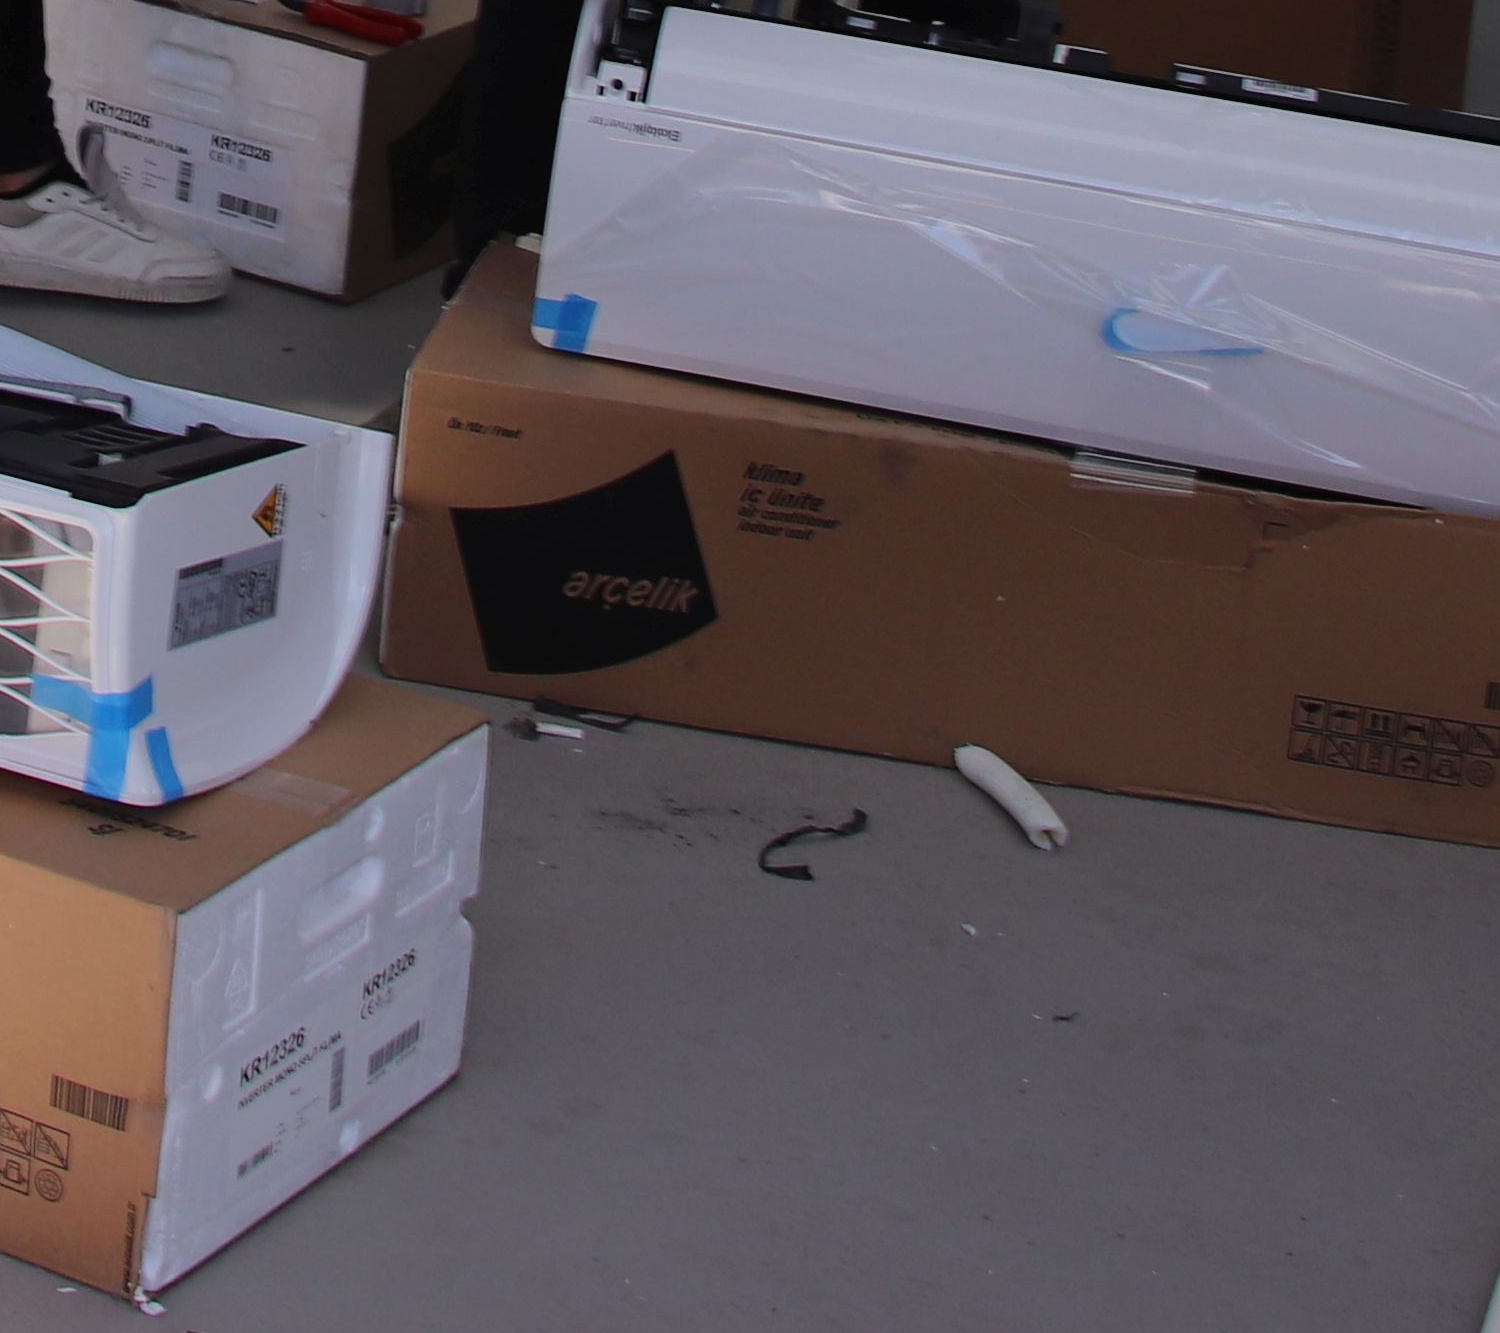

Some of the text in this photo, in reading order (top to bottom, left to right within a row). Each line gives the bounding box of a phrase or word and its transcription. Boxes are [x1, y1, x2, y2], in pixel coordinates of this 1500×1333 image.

[562, 569, 701, 615] arçelik
[361, 948, 417, 1001] KR12326
[239, 1026, 307, 1088] KR12326
